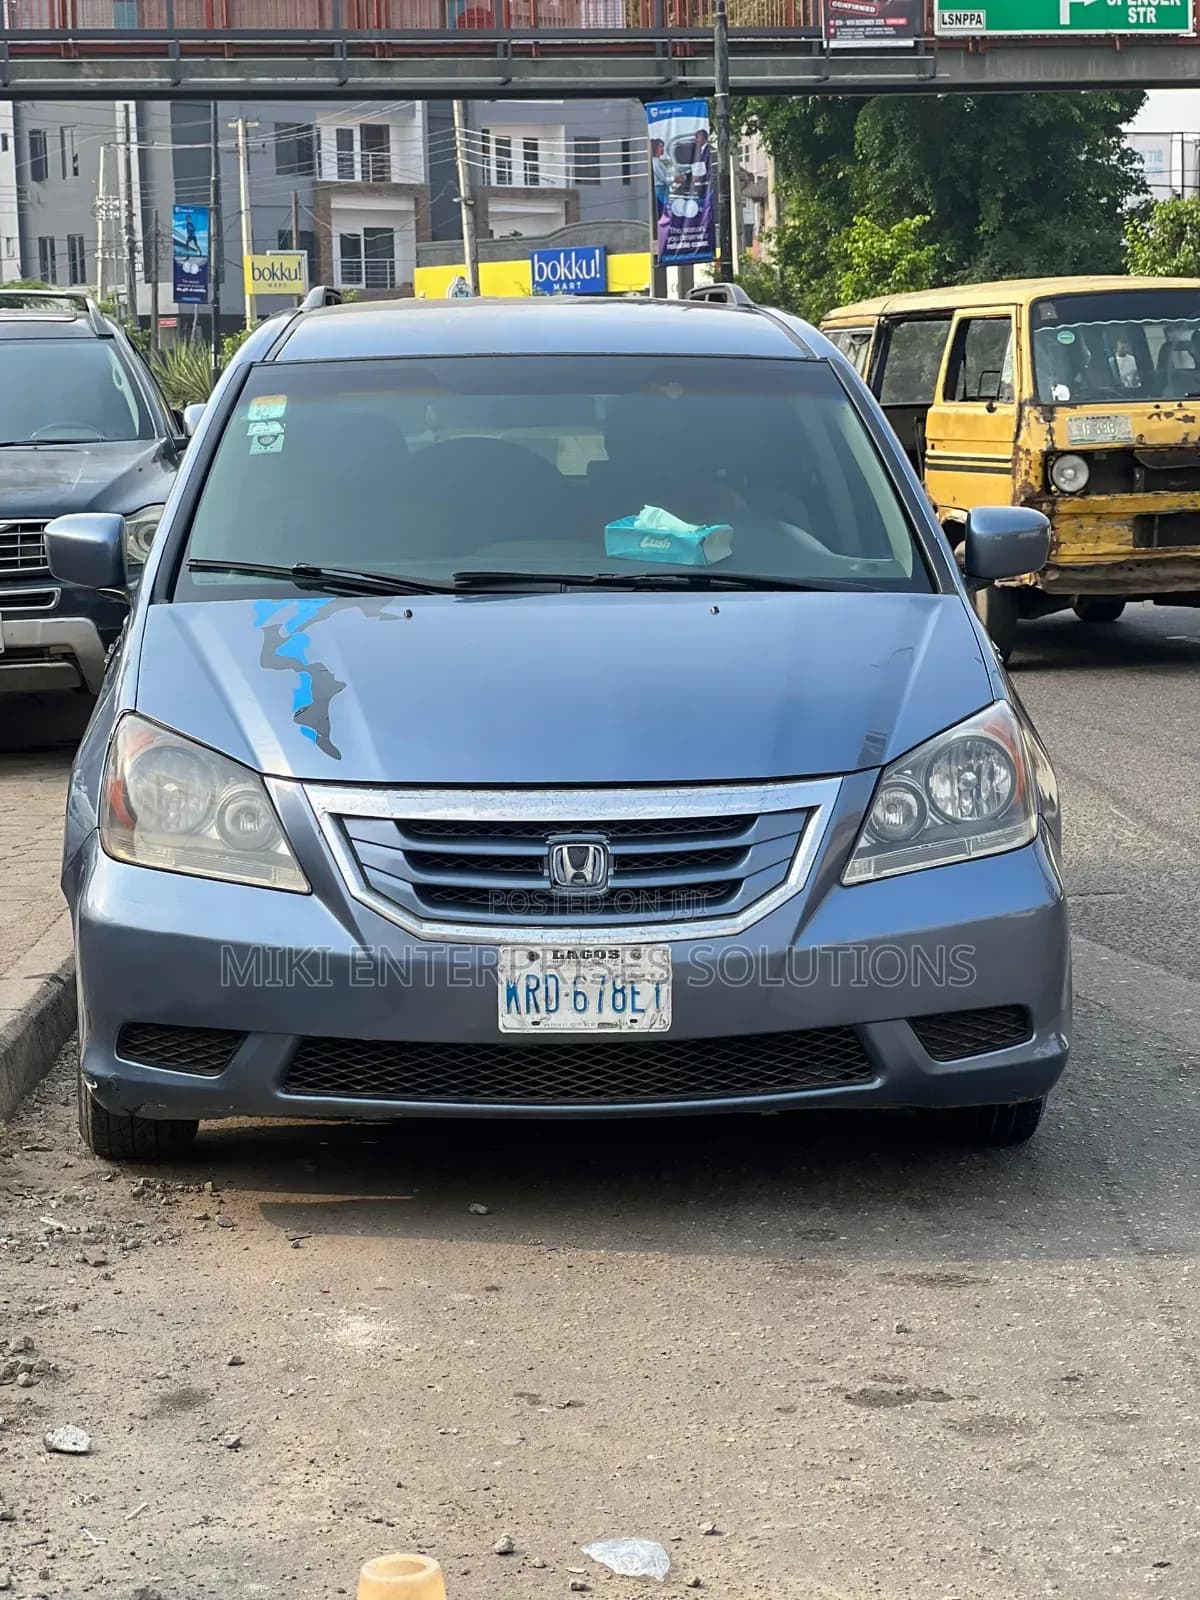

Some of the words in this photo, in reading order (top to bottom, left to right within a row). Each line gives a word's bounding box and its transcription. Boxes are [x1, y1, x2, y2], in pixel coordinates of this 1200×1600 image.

[831, 1, 876, 13] CONFIRMED
[941, 13, 983, 26] LSNPPA
[1128, 7, 1157, 23] STR
[251, 260, 302, 281] bokku!
[534, 248, 600, 282] bokku!
[553, 281, 582, 290] MART
[552, 949, 621, 960] LAGOS
